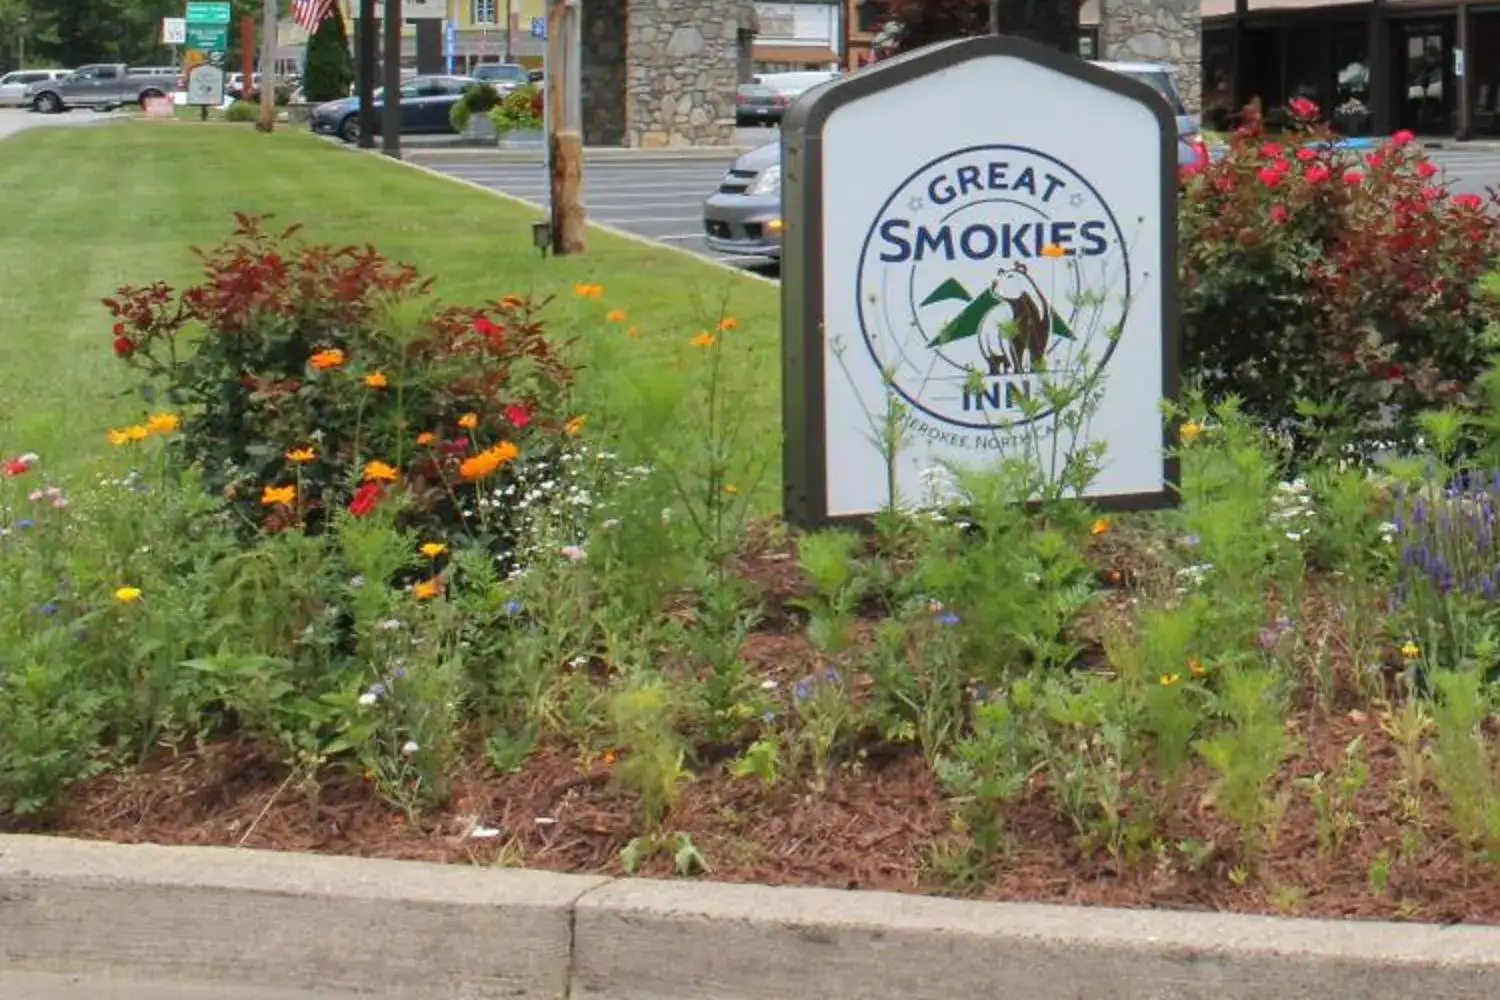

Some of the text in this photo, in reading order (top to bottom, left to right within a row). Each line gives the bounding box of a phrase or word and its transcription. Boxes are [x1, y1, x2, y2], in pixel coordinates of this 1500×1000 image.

[928, 162, 1066, 204] GREAT
[879, 219, 1107, 262] SMOKIES
[963, 380, 1030, 411] INN
